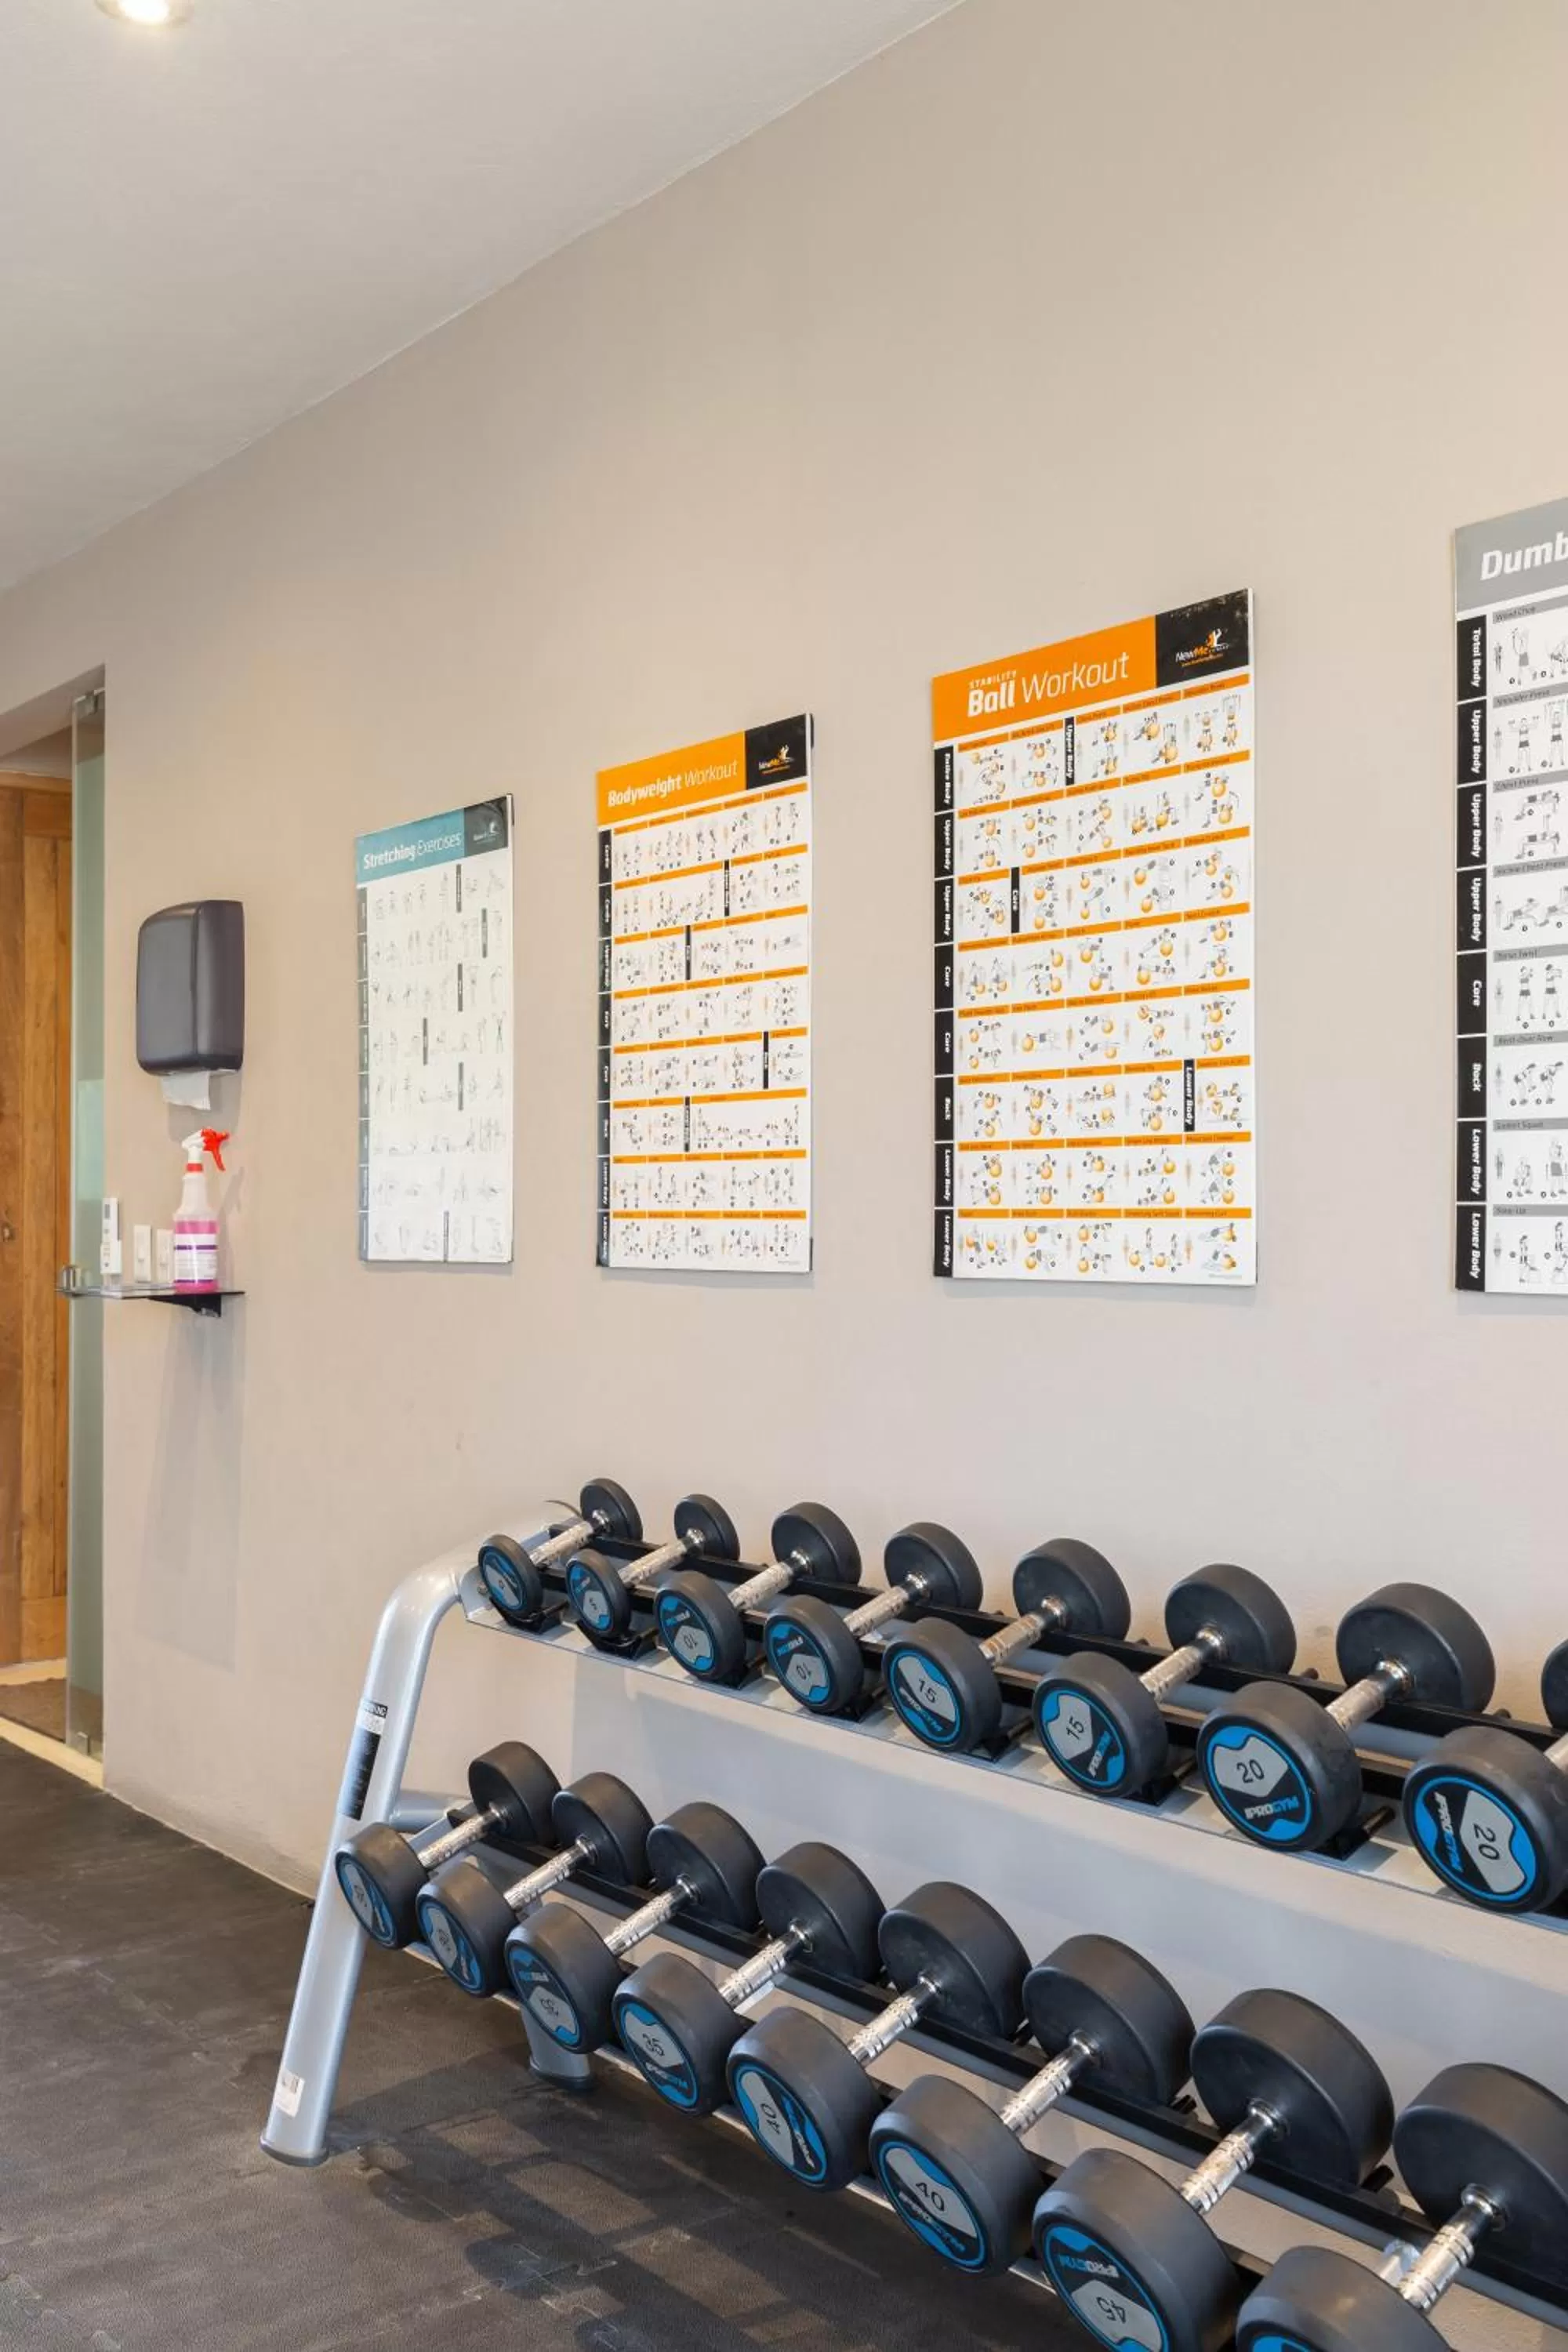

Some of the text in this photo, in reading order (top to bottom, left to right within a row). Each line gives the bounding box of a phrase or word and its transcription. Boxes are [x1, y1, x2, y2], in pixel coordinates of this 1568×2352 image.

[1480, 531, 1568, 581] Dumb
[1471, 627, 1482, 688] Total Body
[967, 680, 1016, 717] Ball
[1022, 652, 1130, 703] Workout
[969, 670, 1017, 689] STABILITY
[1471, 710, 1482, 774] Upper Body
[608, 759, 738, 808] Bodyweight Workout
[1471, 793, 1482, 858] Upper Body
[363, 845, 416, 870] Stretching
[417, 832, 463, 856] Exercises
[1471, 877, 1482, 942] Upper Body
[1472, 980, 1482, 1007] Core
[1472, 1062, 1482, 1092] Back
[1471, 1128, 1482, 1195] Lower Body
[1469, 1213, 1481, 1279] Lower Body
[683, 1632, 698, 1650] 10
[795, 1663, 811, 1680] 10
[917, 1677, 938, 1704] 15
[1065, 1715, 1085, 1740] 15
[1236, 1759, 1265, 1784] 20
[1473, 1823, 1501, 1860] 20
[642, 2032, 666, 2058] 35
[760, 2102, 782, 2135] 40
[915, 2182, 946, 2212] 40
[1095, 2296, 1127, 2324] 45
